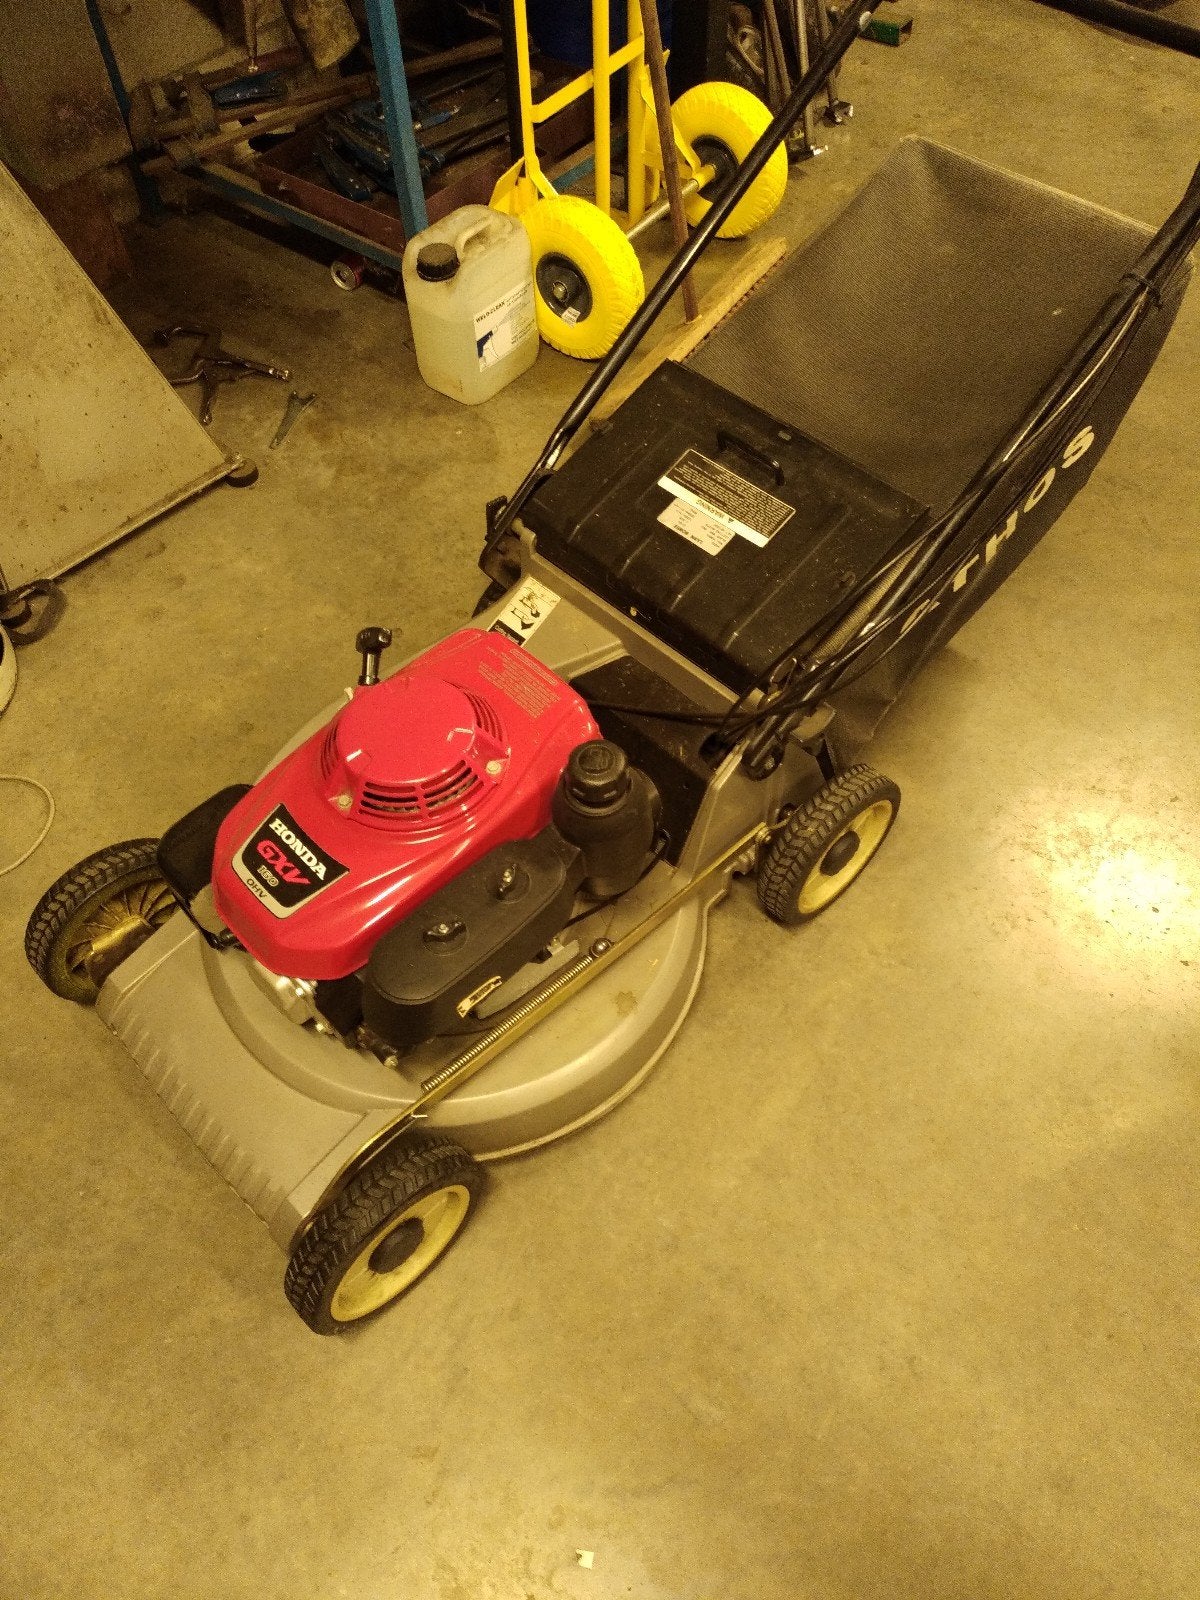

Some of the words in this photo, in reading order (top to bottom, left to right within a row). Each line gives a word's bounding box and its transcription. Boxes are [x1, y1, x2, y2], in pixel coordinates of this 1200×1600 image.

[256, 839, 311, 885] GXV
[268, 818, 327, 881] HONDA
[246, 877, 268, 899] OHV
